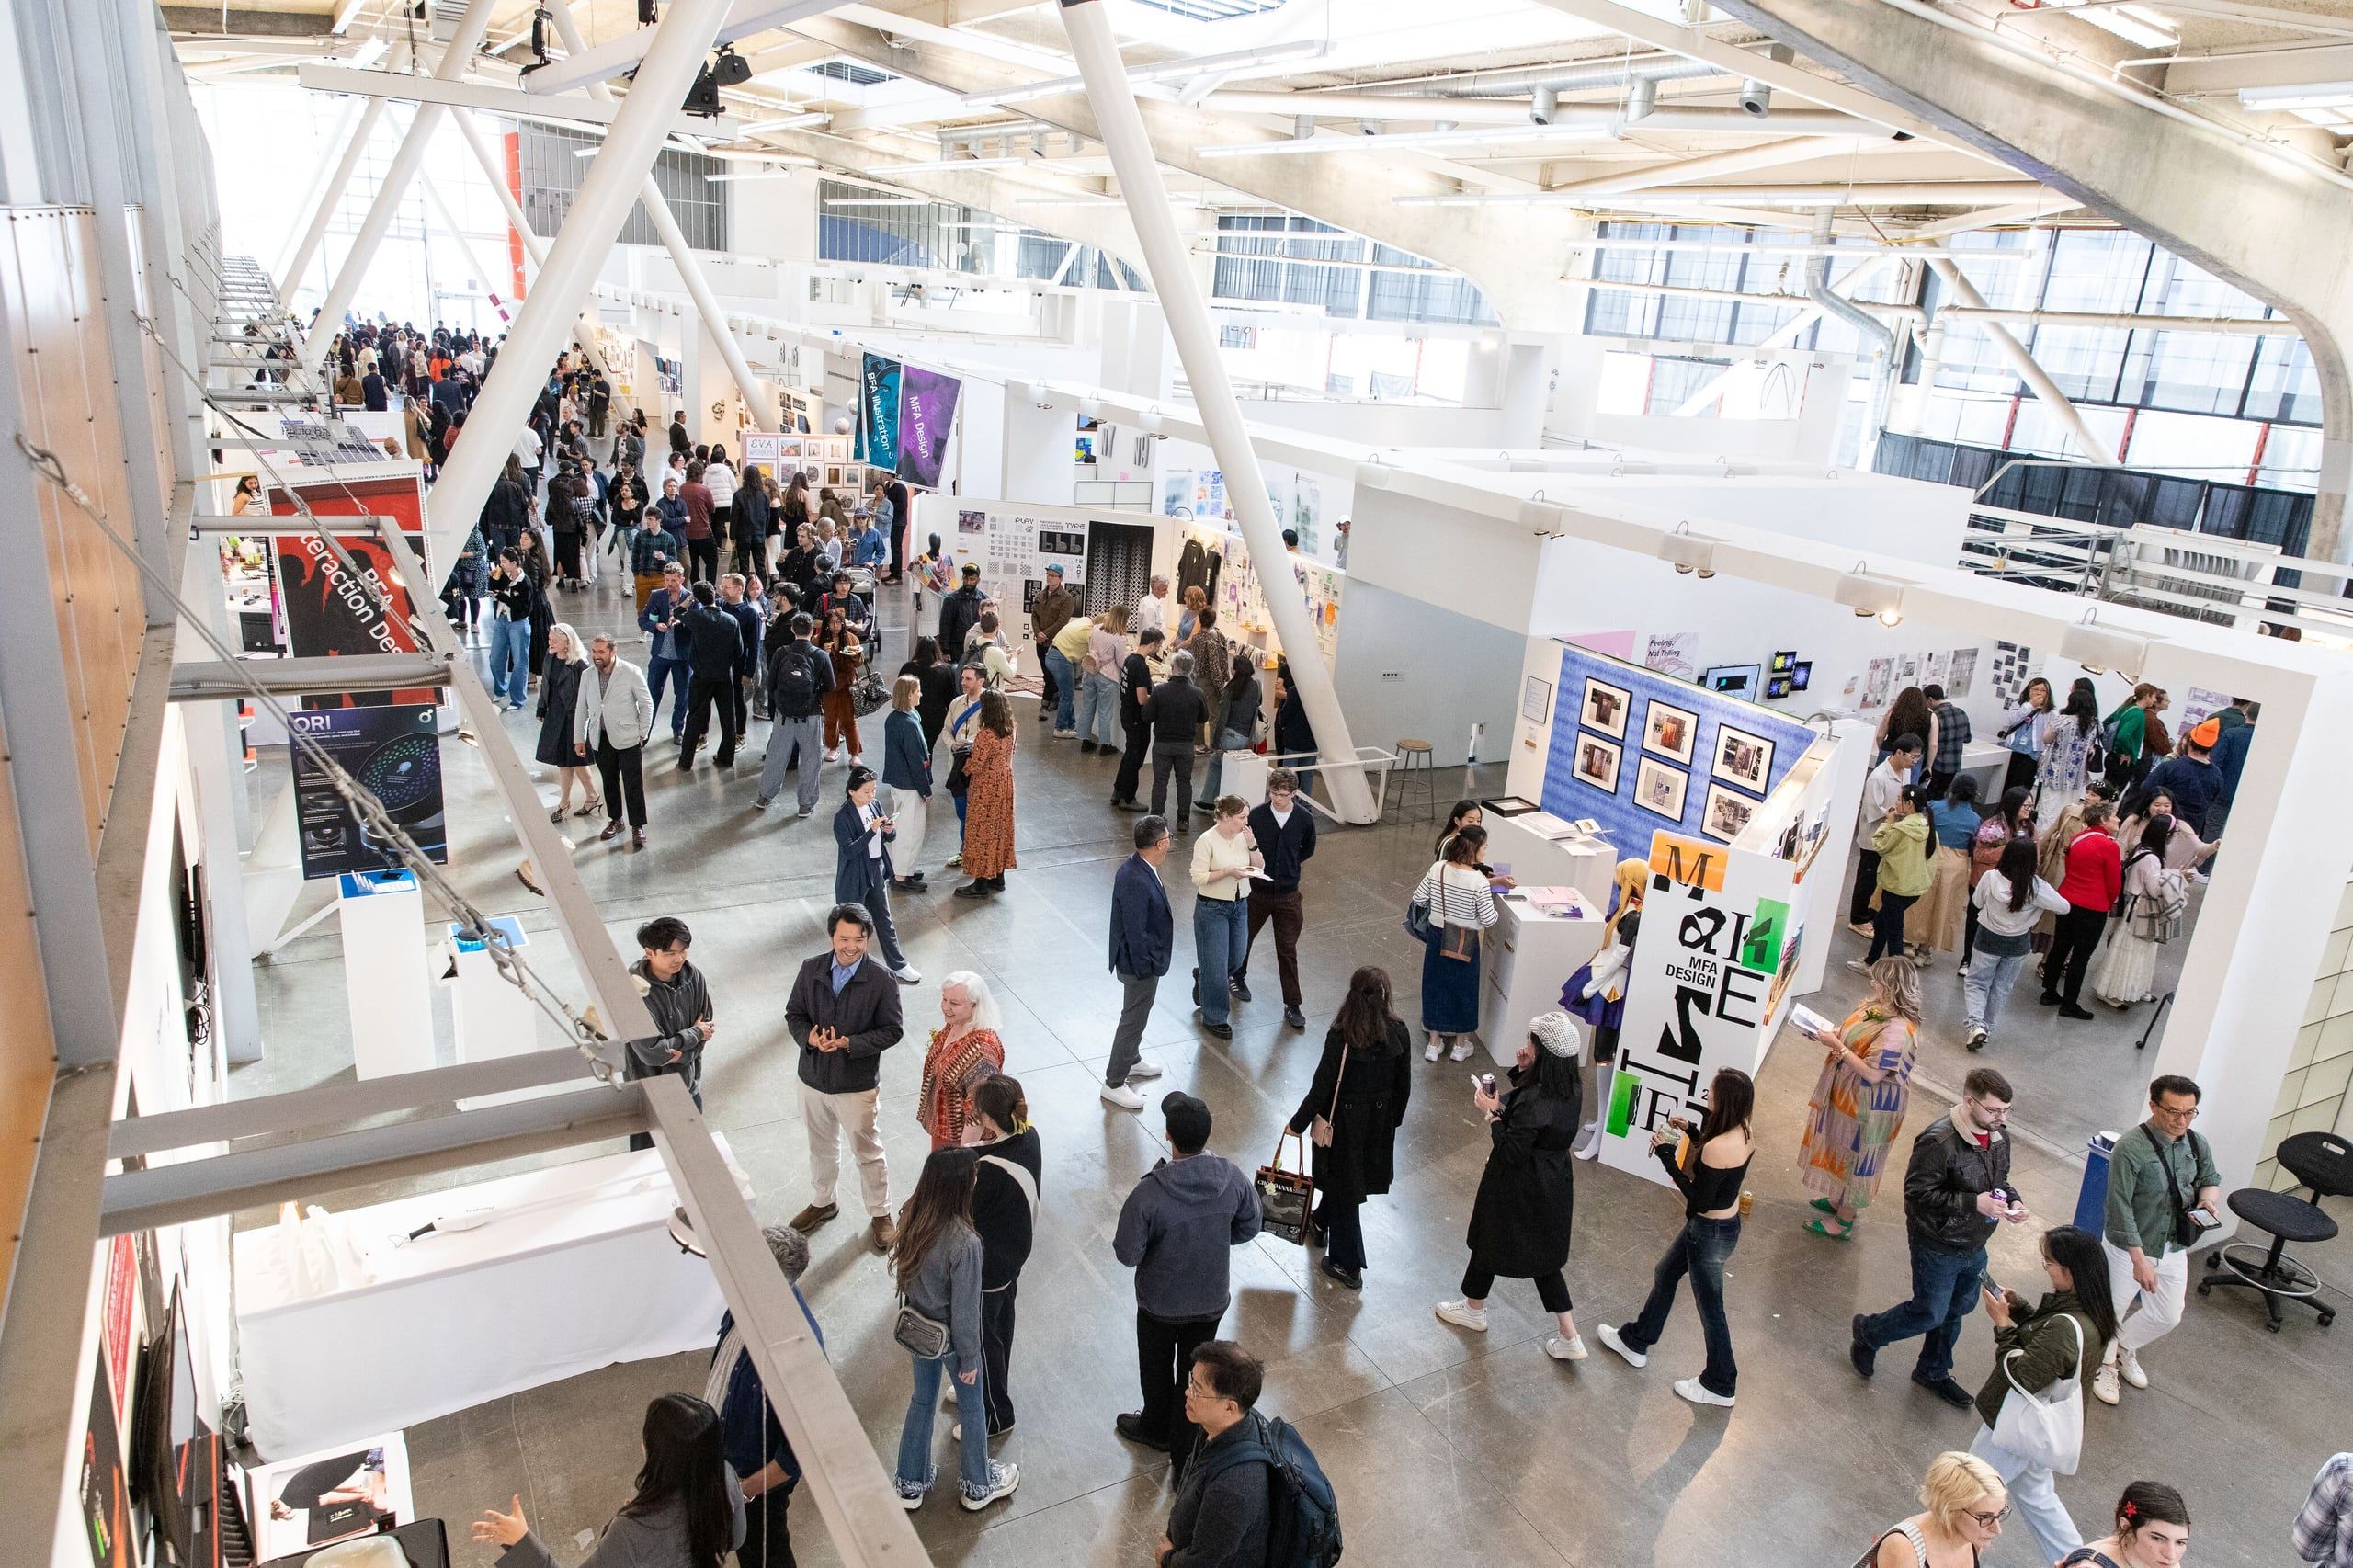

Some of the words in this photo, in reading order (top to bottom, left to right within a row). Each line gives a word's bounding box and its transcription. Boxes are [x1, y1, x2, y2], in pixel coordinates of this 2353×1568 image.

[868, 372, 878, 393] BFA
[871, 395, 890, 451] Illustration
[909, 396, 920, 421] MFA
[915, 423, 929, 459] Design
[1662, 649, 1680, 658] Telling
[293, 715, 331, 733] ORI
[1688, 956, 1718, 975] MFA
[1665, 964, 1717, 989] DESIGN
